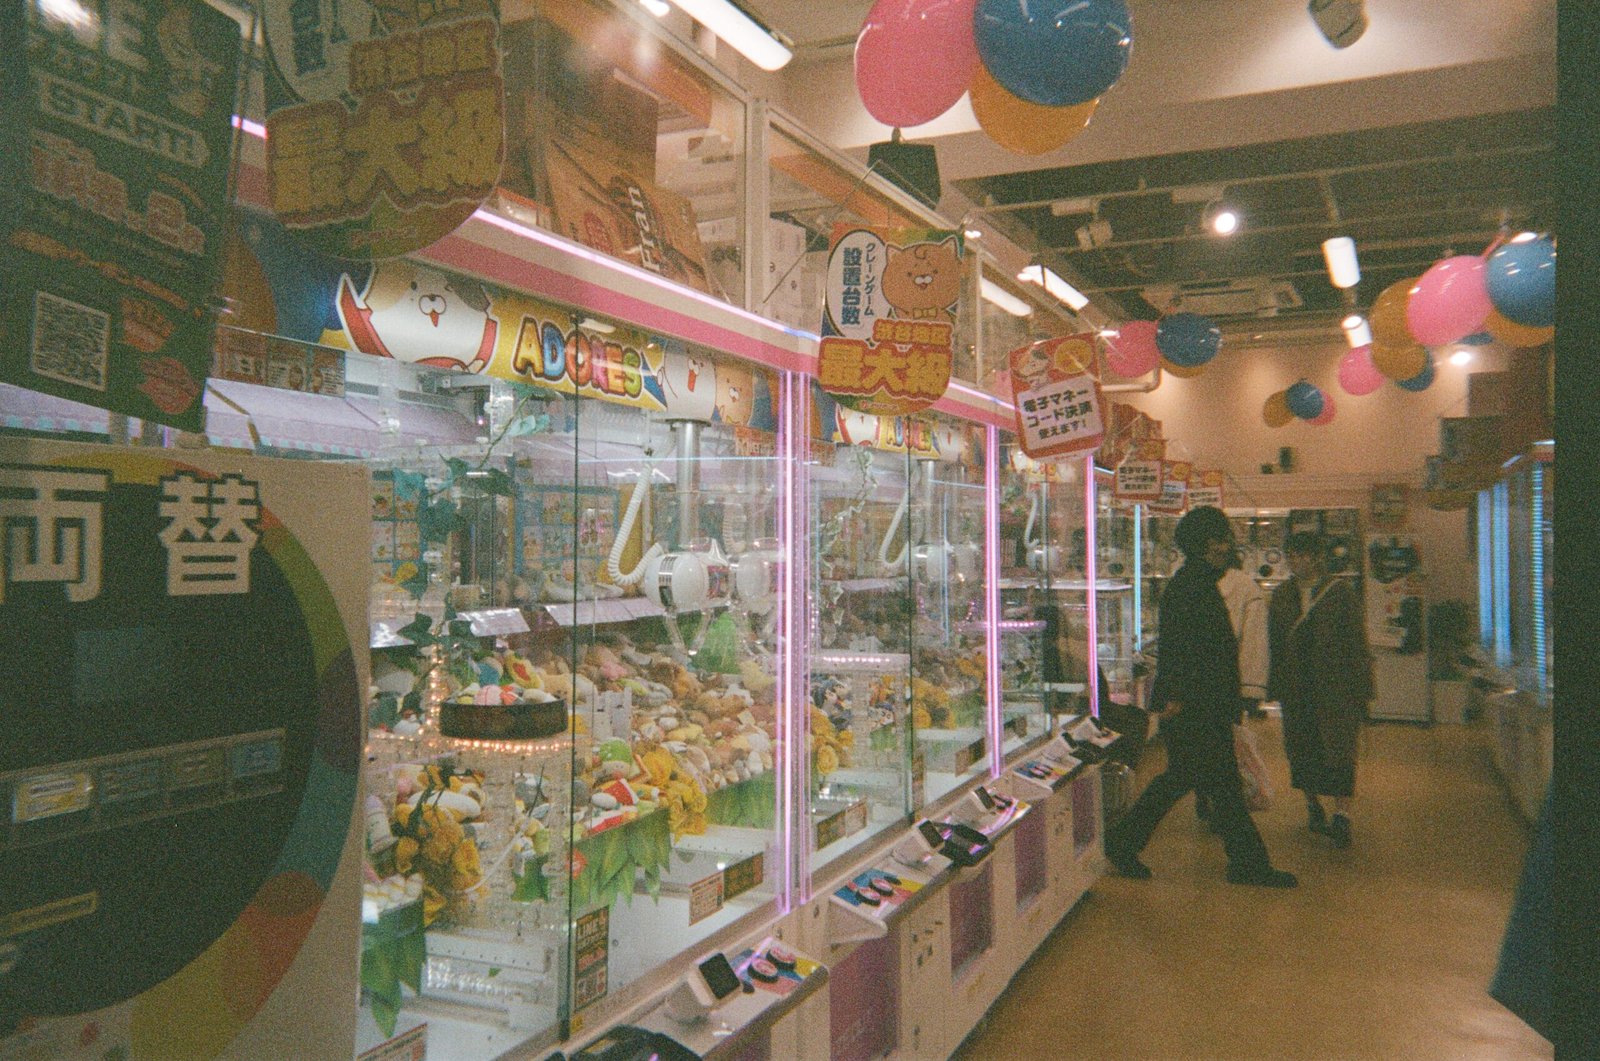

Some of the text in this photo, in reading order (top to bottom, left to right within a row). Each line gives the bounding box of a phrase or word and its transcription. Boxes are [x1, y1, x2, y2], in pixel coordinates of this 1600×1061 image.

[274, 89, 502, 213] 最大級
[841, 247, 862, 325] 設置台数
[864, 242, 876, 316] クレーンゲーム
[512, 315, 643, 398] ADORES
[821, 343, 948, 395] 最大級
[1023, 388, 1089, 413] 電子マネー
[1026, 401, 1093, 428] コード決済
[1038, 420, 1087, 440] 使えます!
[0, 469, 262, 602] 両替
